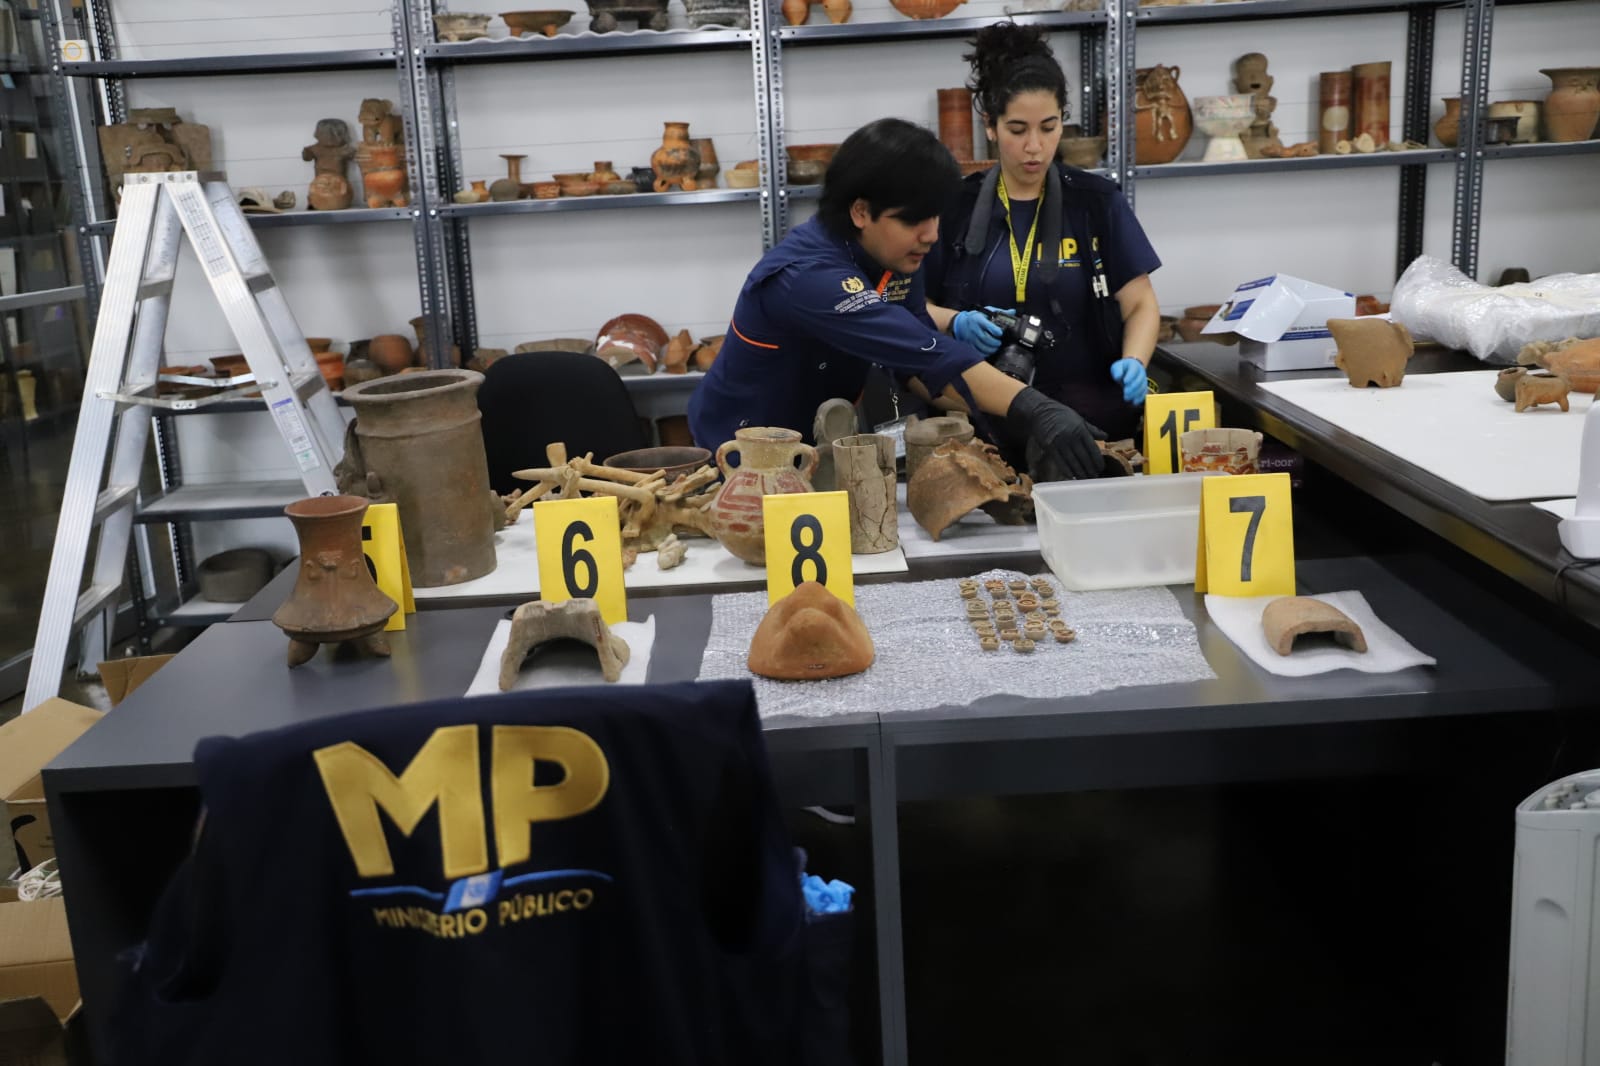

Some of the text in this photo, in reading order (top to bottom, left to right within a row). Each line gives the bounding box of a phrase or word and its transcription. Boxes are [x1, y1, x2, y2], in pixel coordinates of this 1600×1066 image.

[1257, 457, 1294, 468] ri-cor
[561, 520, 599, 598] 6
[790, 513, 828, 587] 8
[1229, 496, 1266, 582] 7
[312, 724, 610, 880] MP
[498, 887, 594, 926] PÚBLICO
